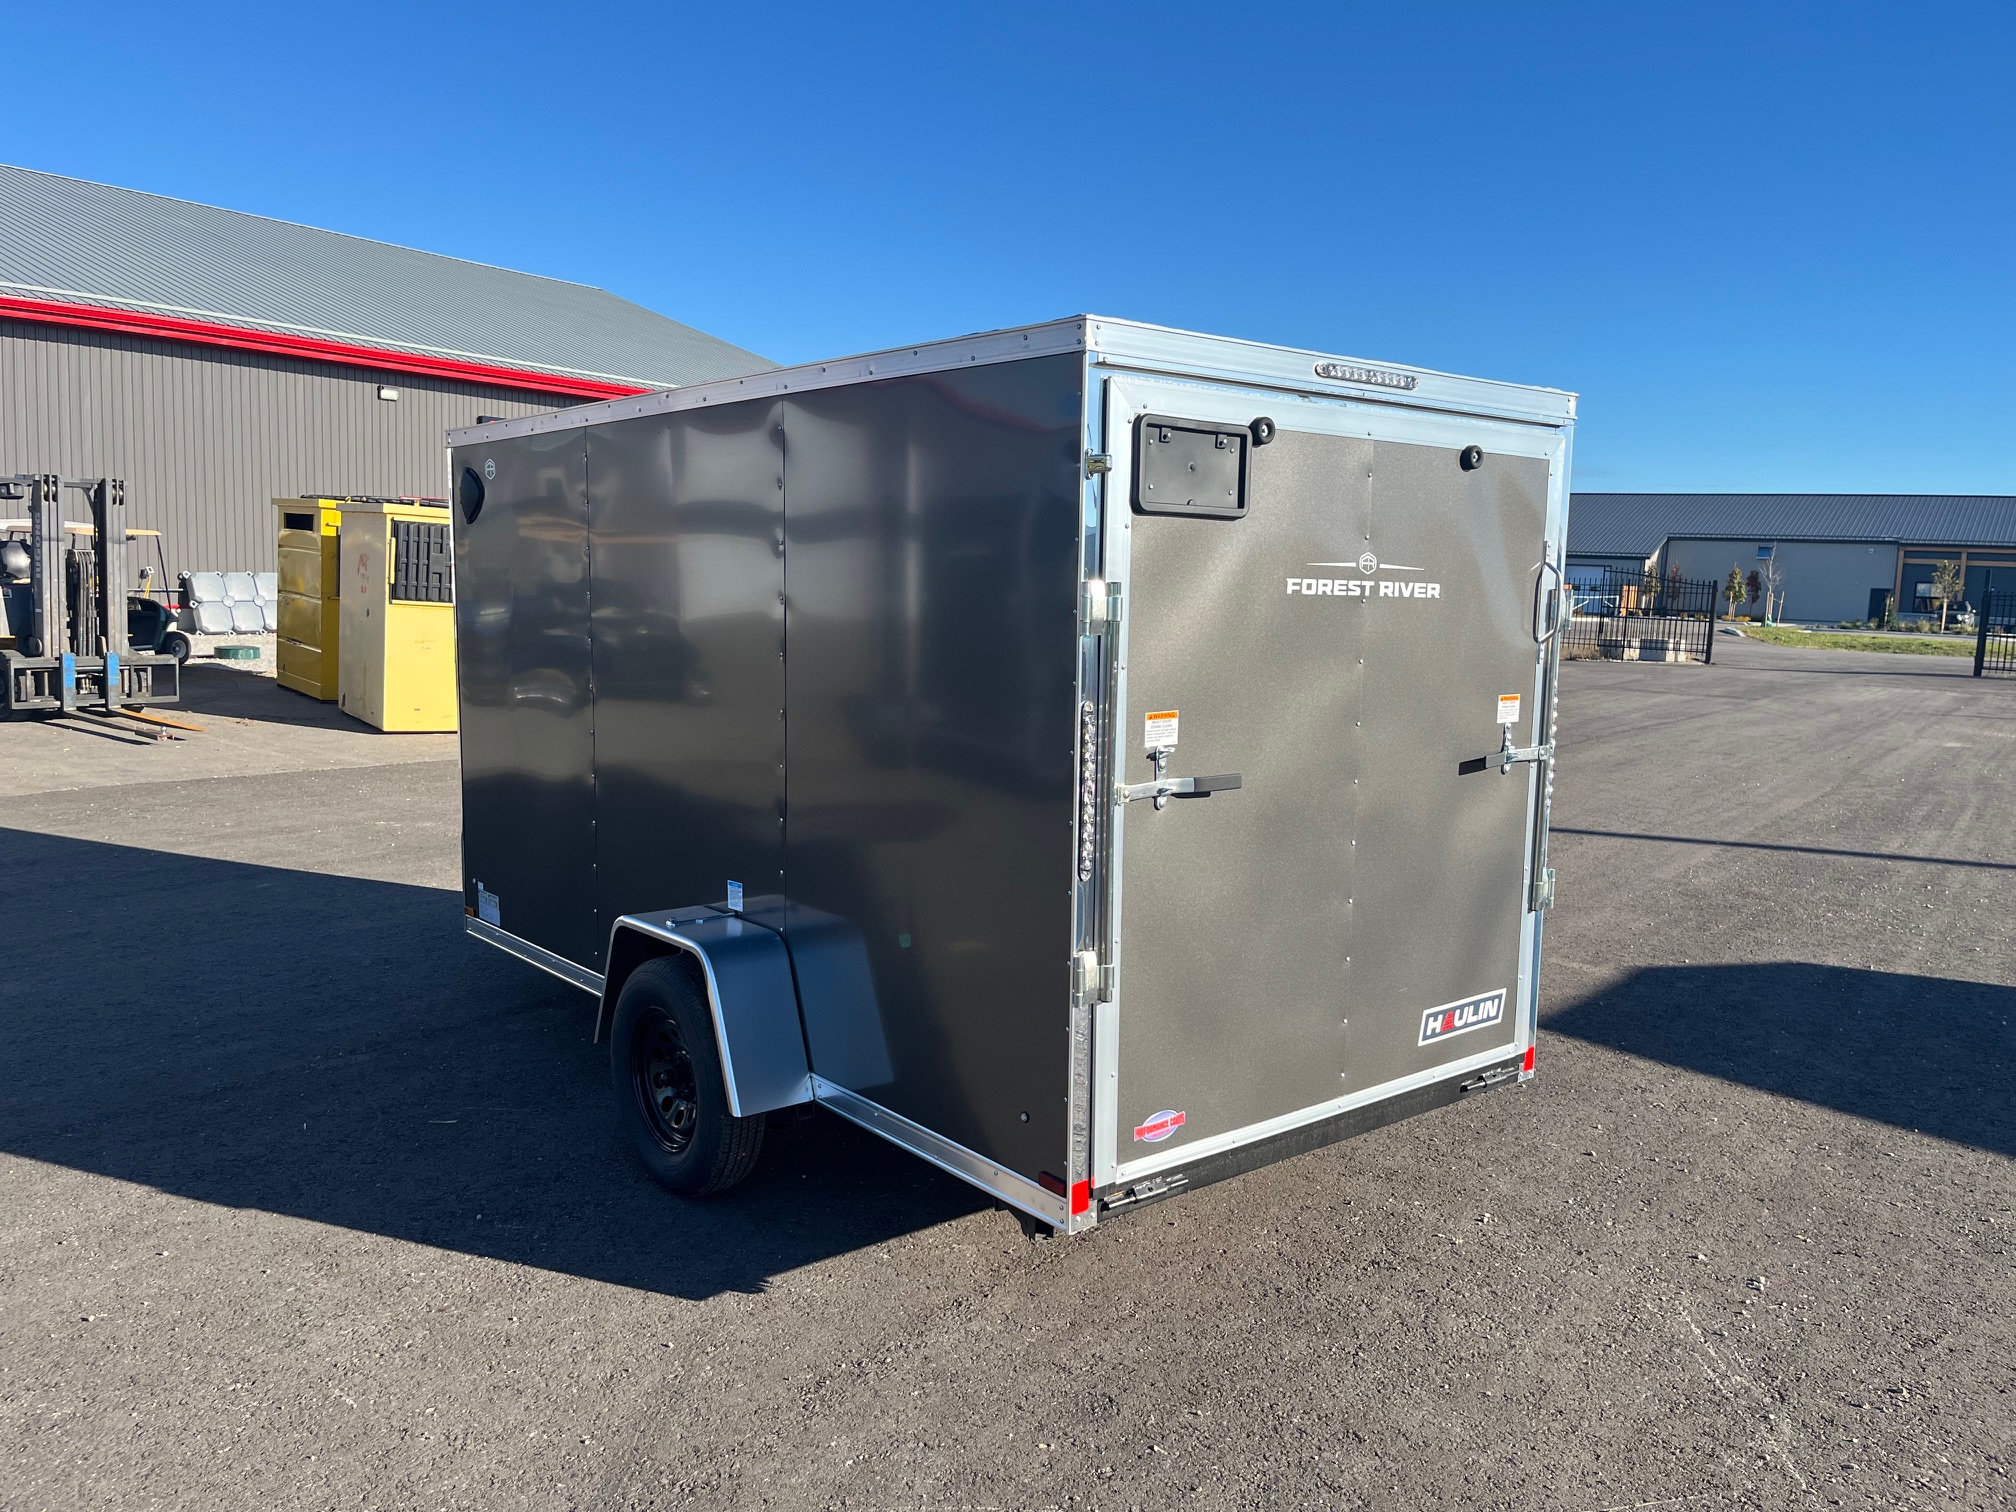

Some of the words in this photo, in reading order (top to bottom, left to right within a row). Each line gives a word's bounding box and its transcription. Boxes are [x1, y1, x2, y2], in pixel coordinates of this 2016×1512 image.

[1286, 578, 1375, 597] FOREST
[1378, 581, 1441, 599] RIVER
[1426, 998, 1500, 1036] HAULIN
